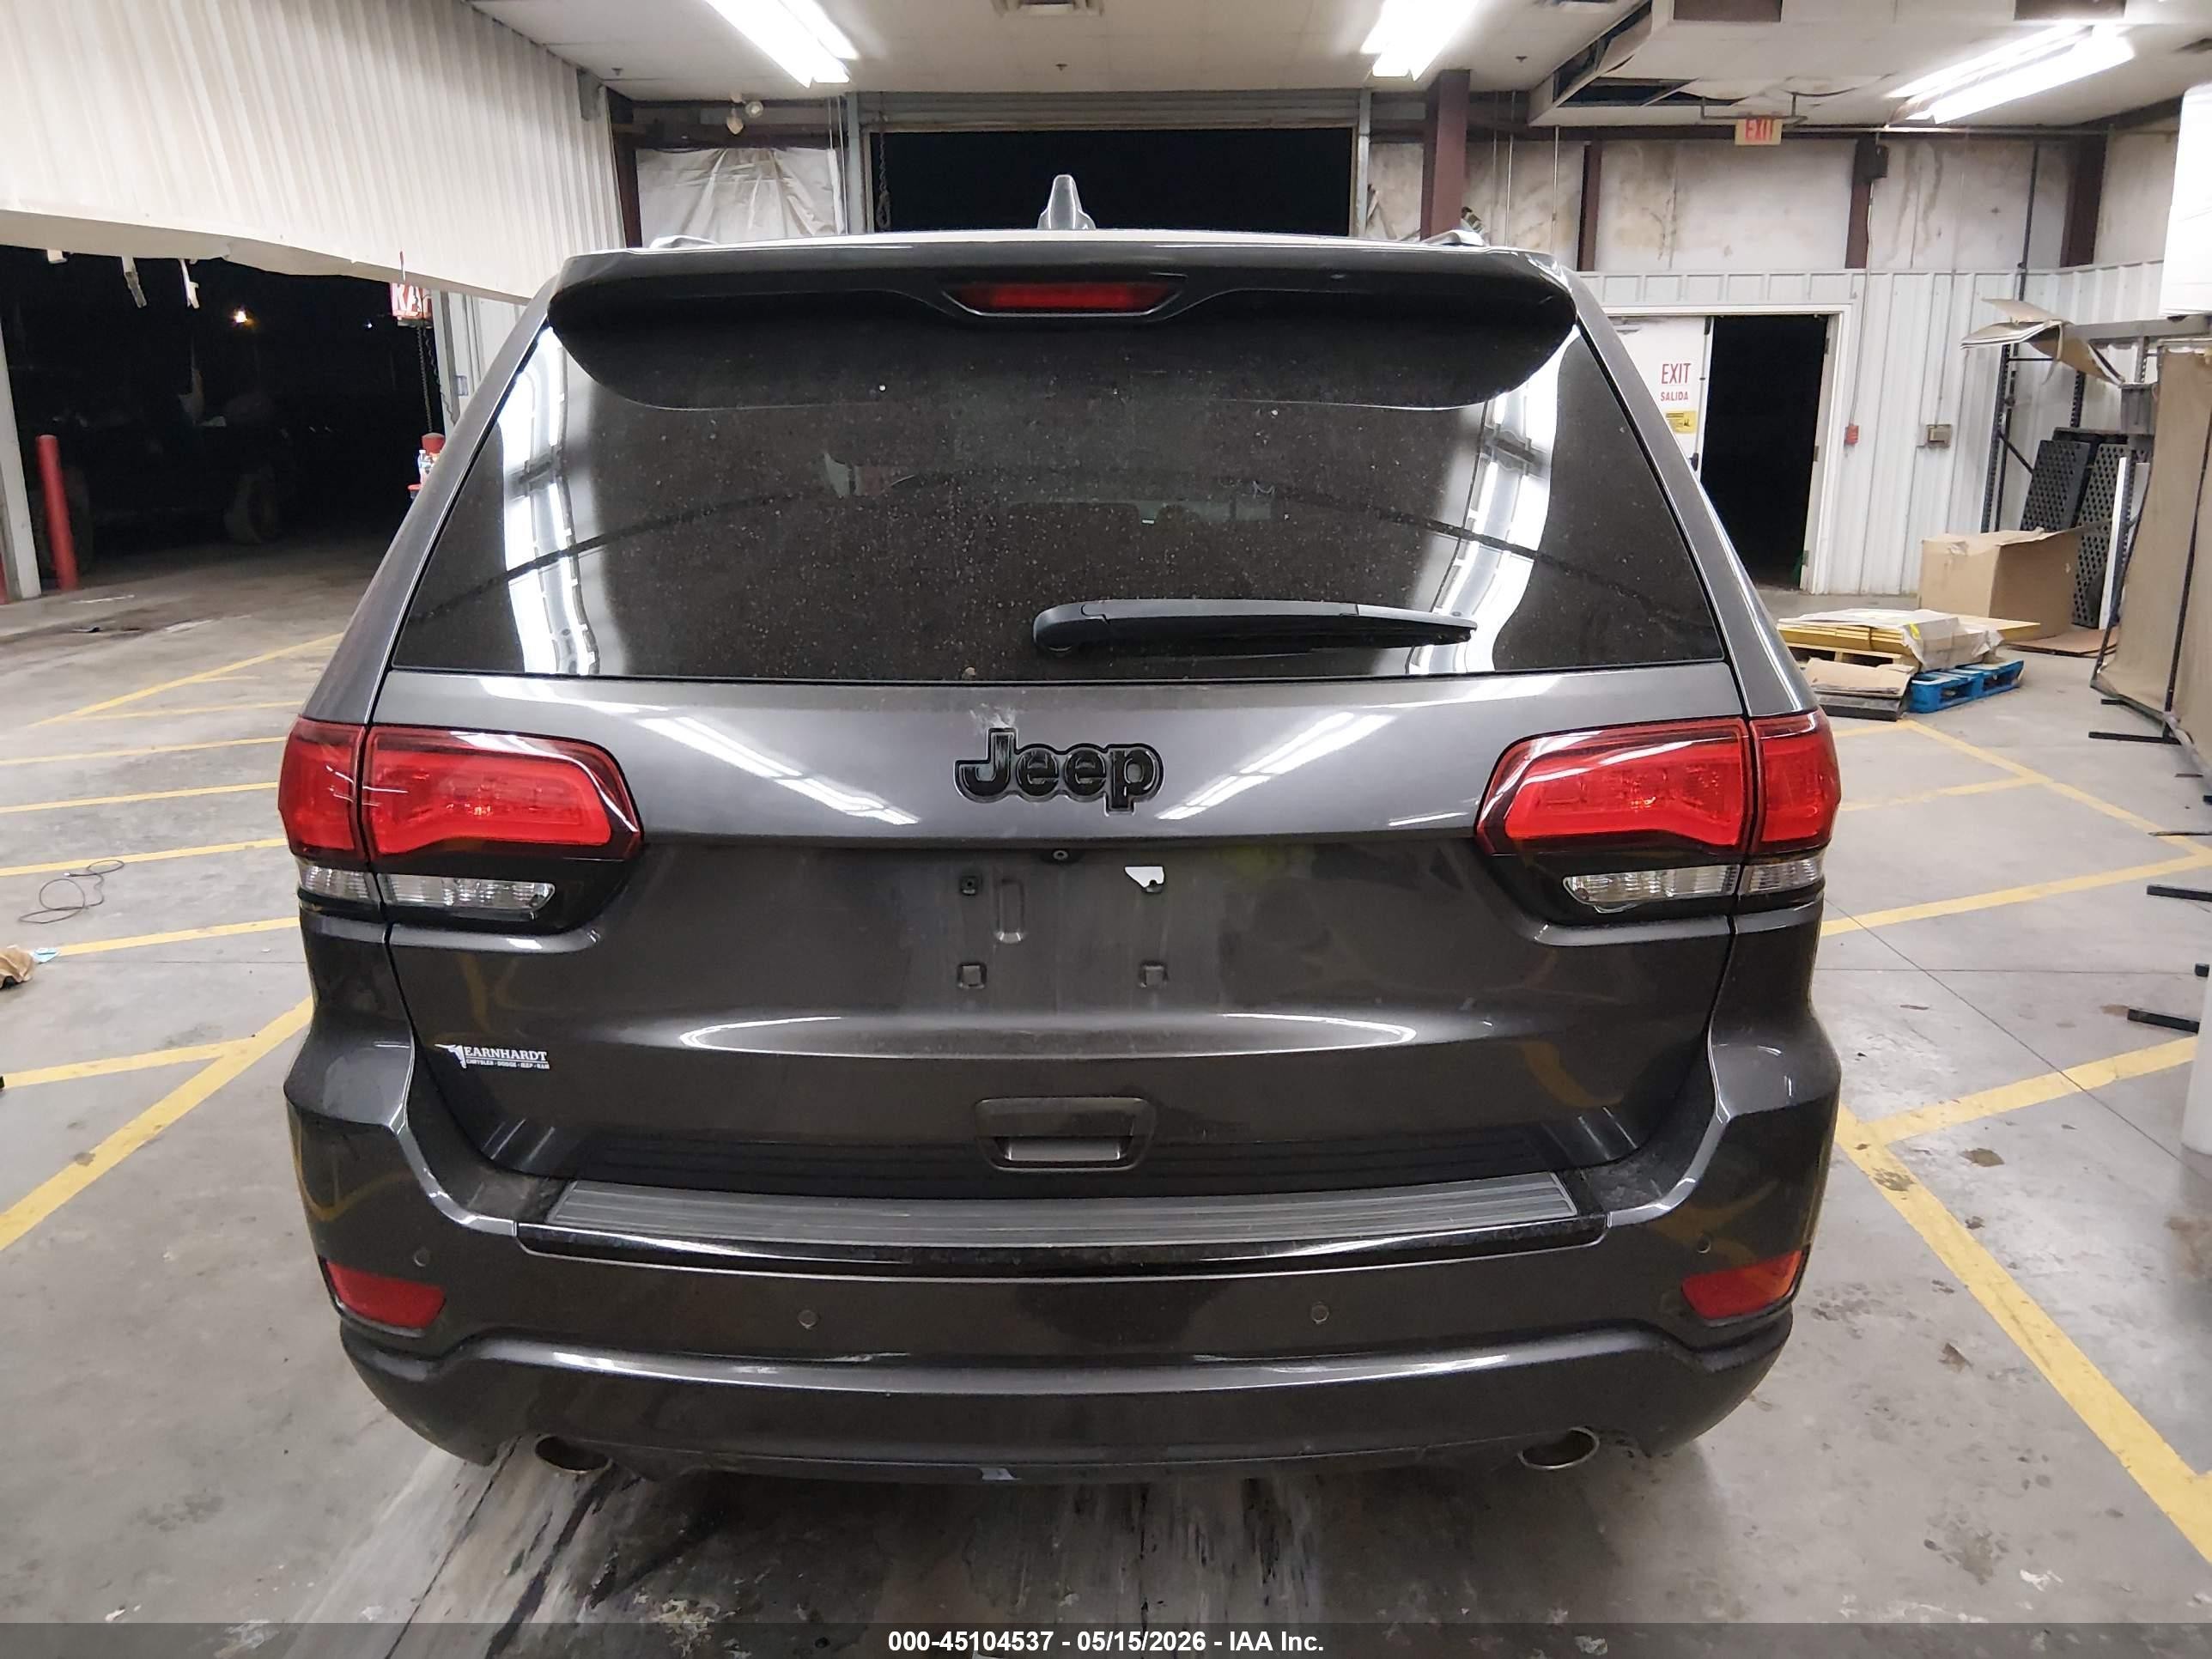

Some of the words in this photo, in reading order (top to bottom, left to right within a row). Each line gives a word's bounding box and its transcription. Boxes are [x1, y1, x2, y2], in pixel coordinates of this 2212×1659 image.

[1661, 362, 1692, 385] EXIT
[1660, 391, 1689, 402] SALIDA
[955, 728, 1164, 815] Jeep
[464, 1046, 548, 1061] EARNHARDT
